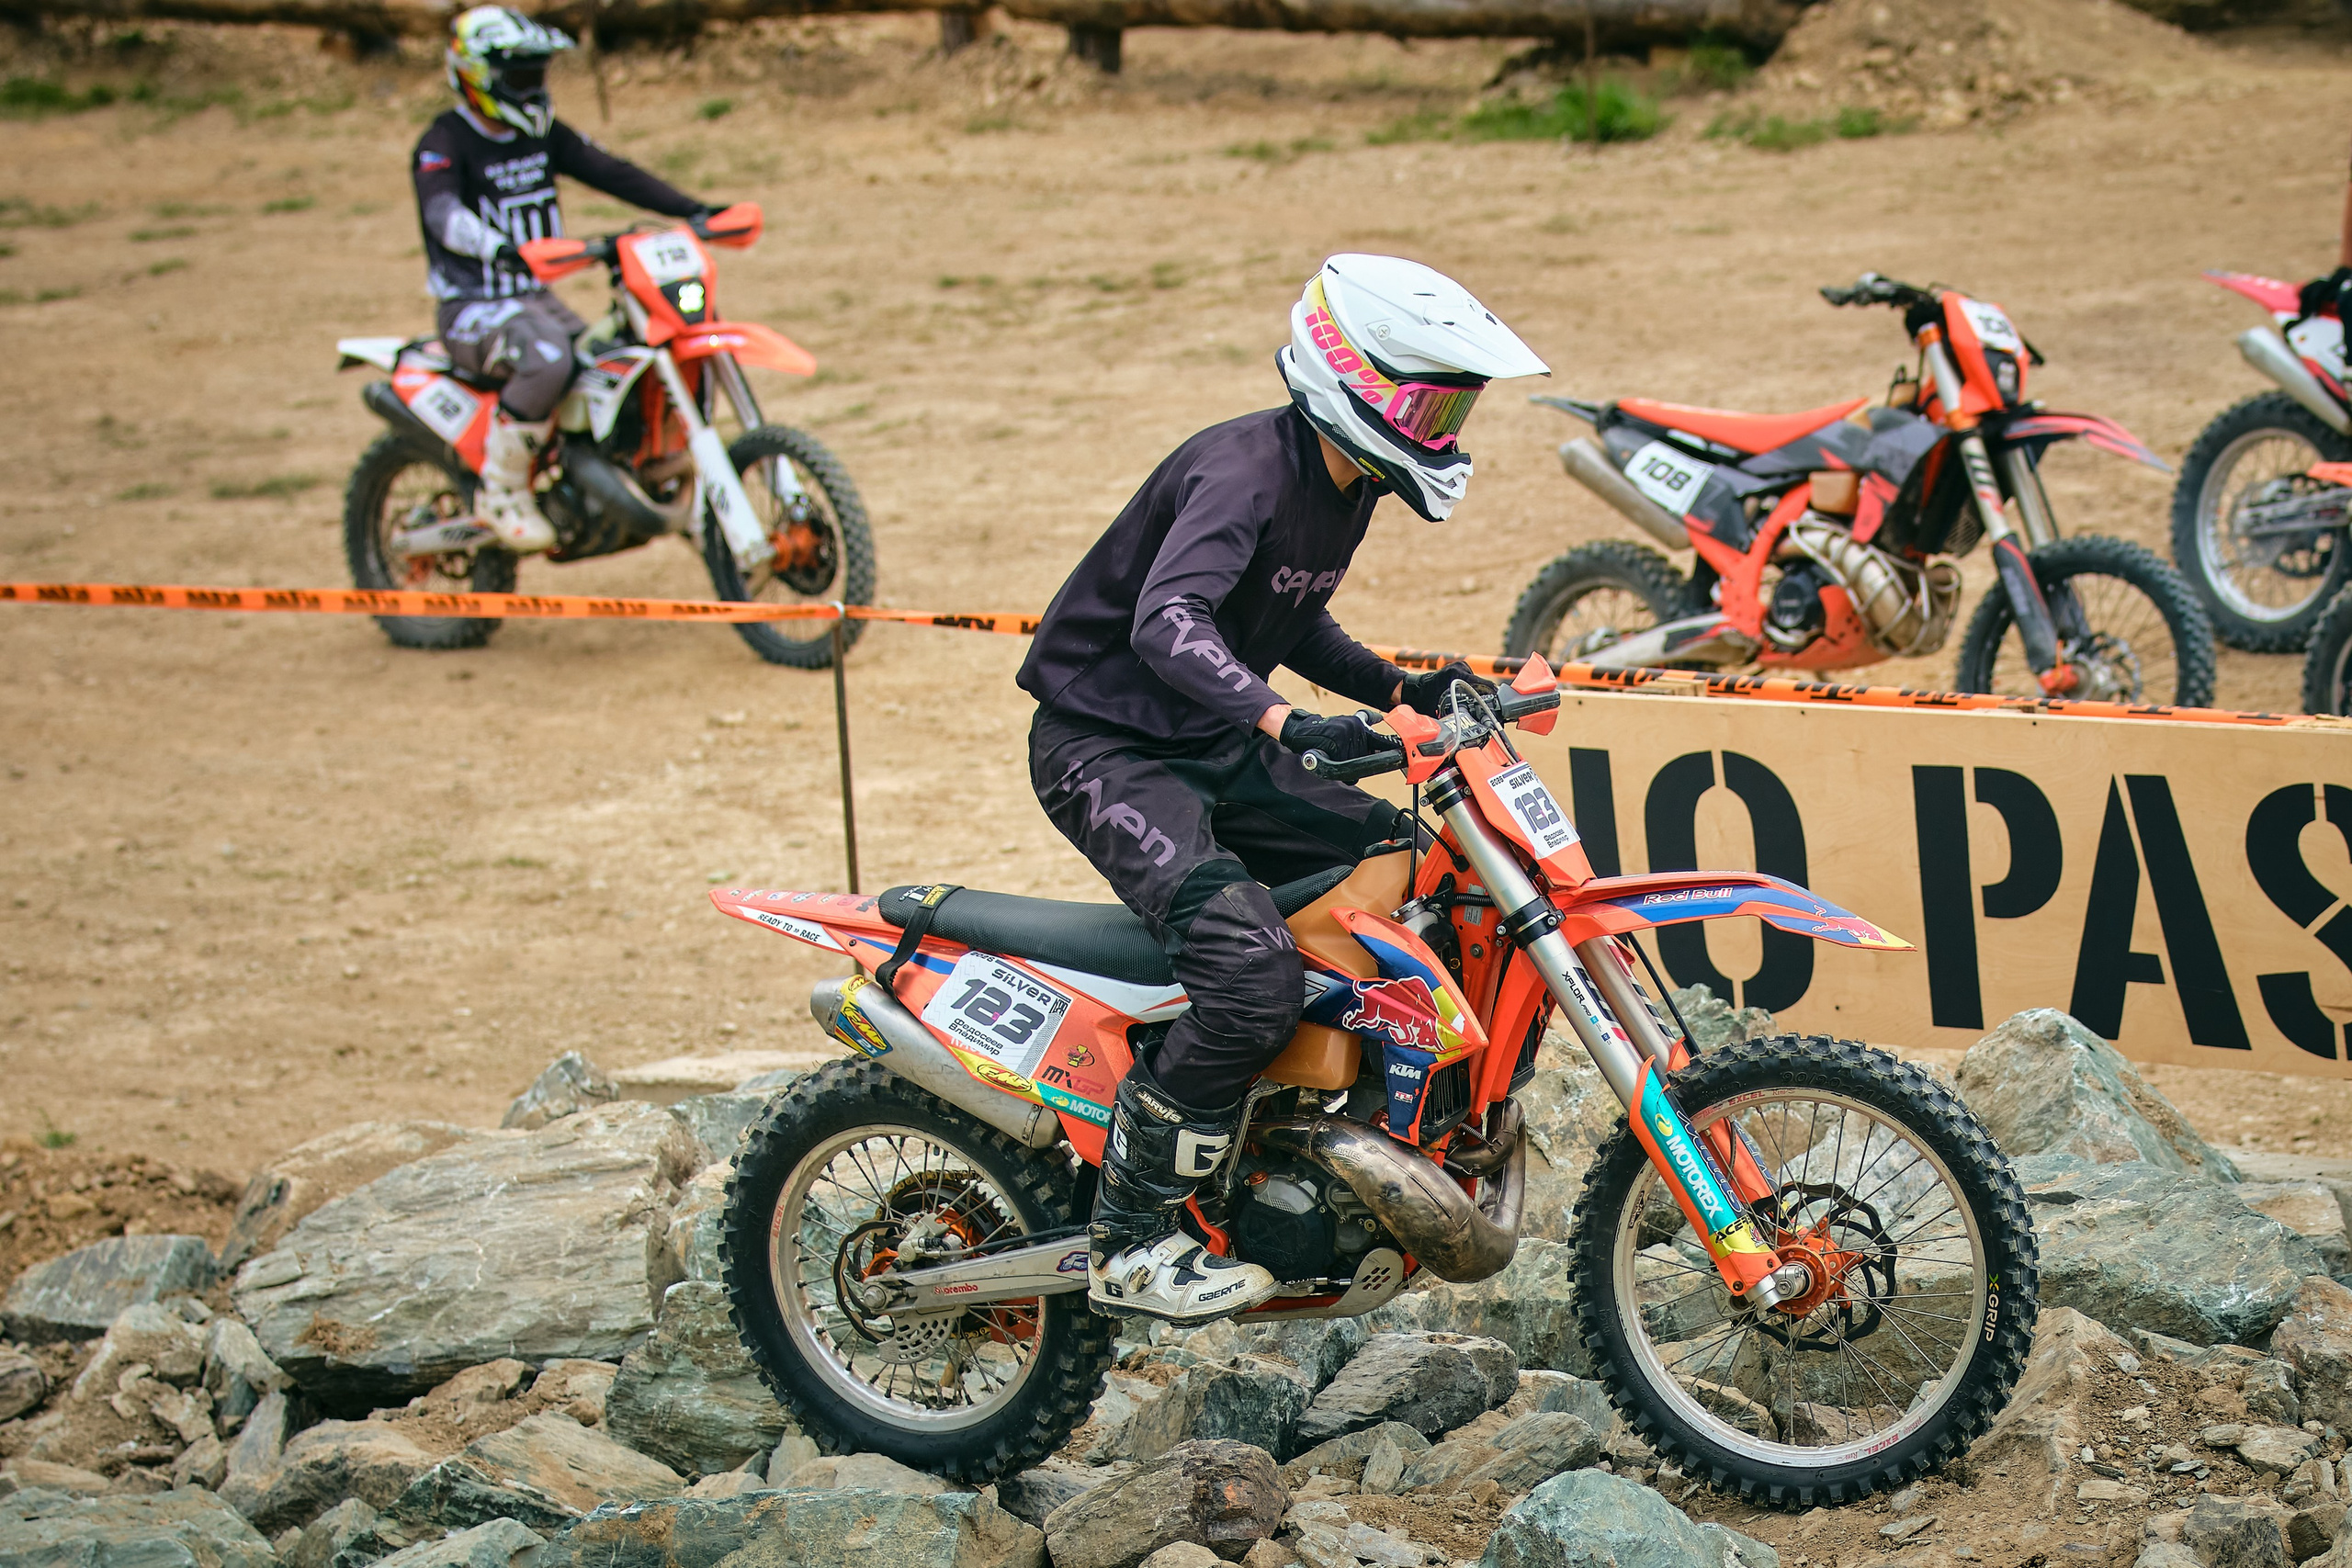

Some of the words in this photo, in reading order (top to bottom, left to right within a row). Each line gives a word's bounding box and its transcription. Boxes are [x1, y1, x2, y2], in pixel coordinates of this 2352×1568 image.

[1305, 306, 1394, 405] 100%
[1640, 457, 1691, 491] 108
[1514, 786, 1561, 834] 123
[1643, 889, 1690, 906] Red
[1690, 887, 1734, 901] Bull
[757, 913, 783, 927] READY
[782, 922, 794, 931] TO
[799, 928, 821, 942] RACE
[1562, 970, 1586, 1005] XPLOR
[950, 978, 1046, 1045] 123
[843, 1008, 888, 1049] FMF
[948, 1023, 1001, 1055] Владимир
[954, 1018, 1004, 1050] Федосеев
[980, 1066, 1032, 1089] FMF
[1041, 1066, 1106, 1096] MXGP
[1388, 1063, 1422, 1080] KTM
[1728, 1090, 1766, 1106] EXCEL
[1665, 1134, 1724, 1219] MOTOREX
[1984, 1273, 1999, 1342] X-GRIP
[1863, 1433, 1899, 1455] EXCEL
